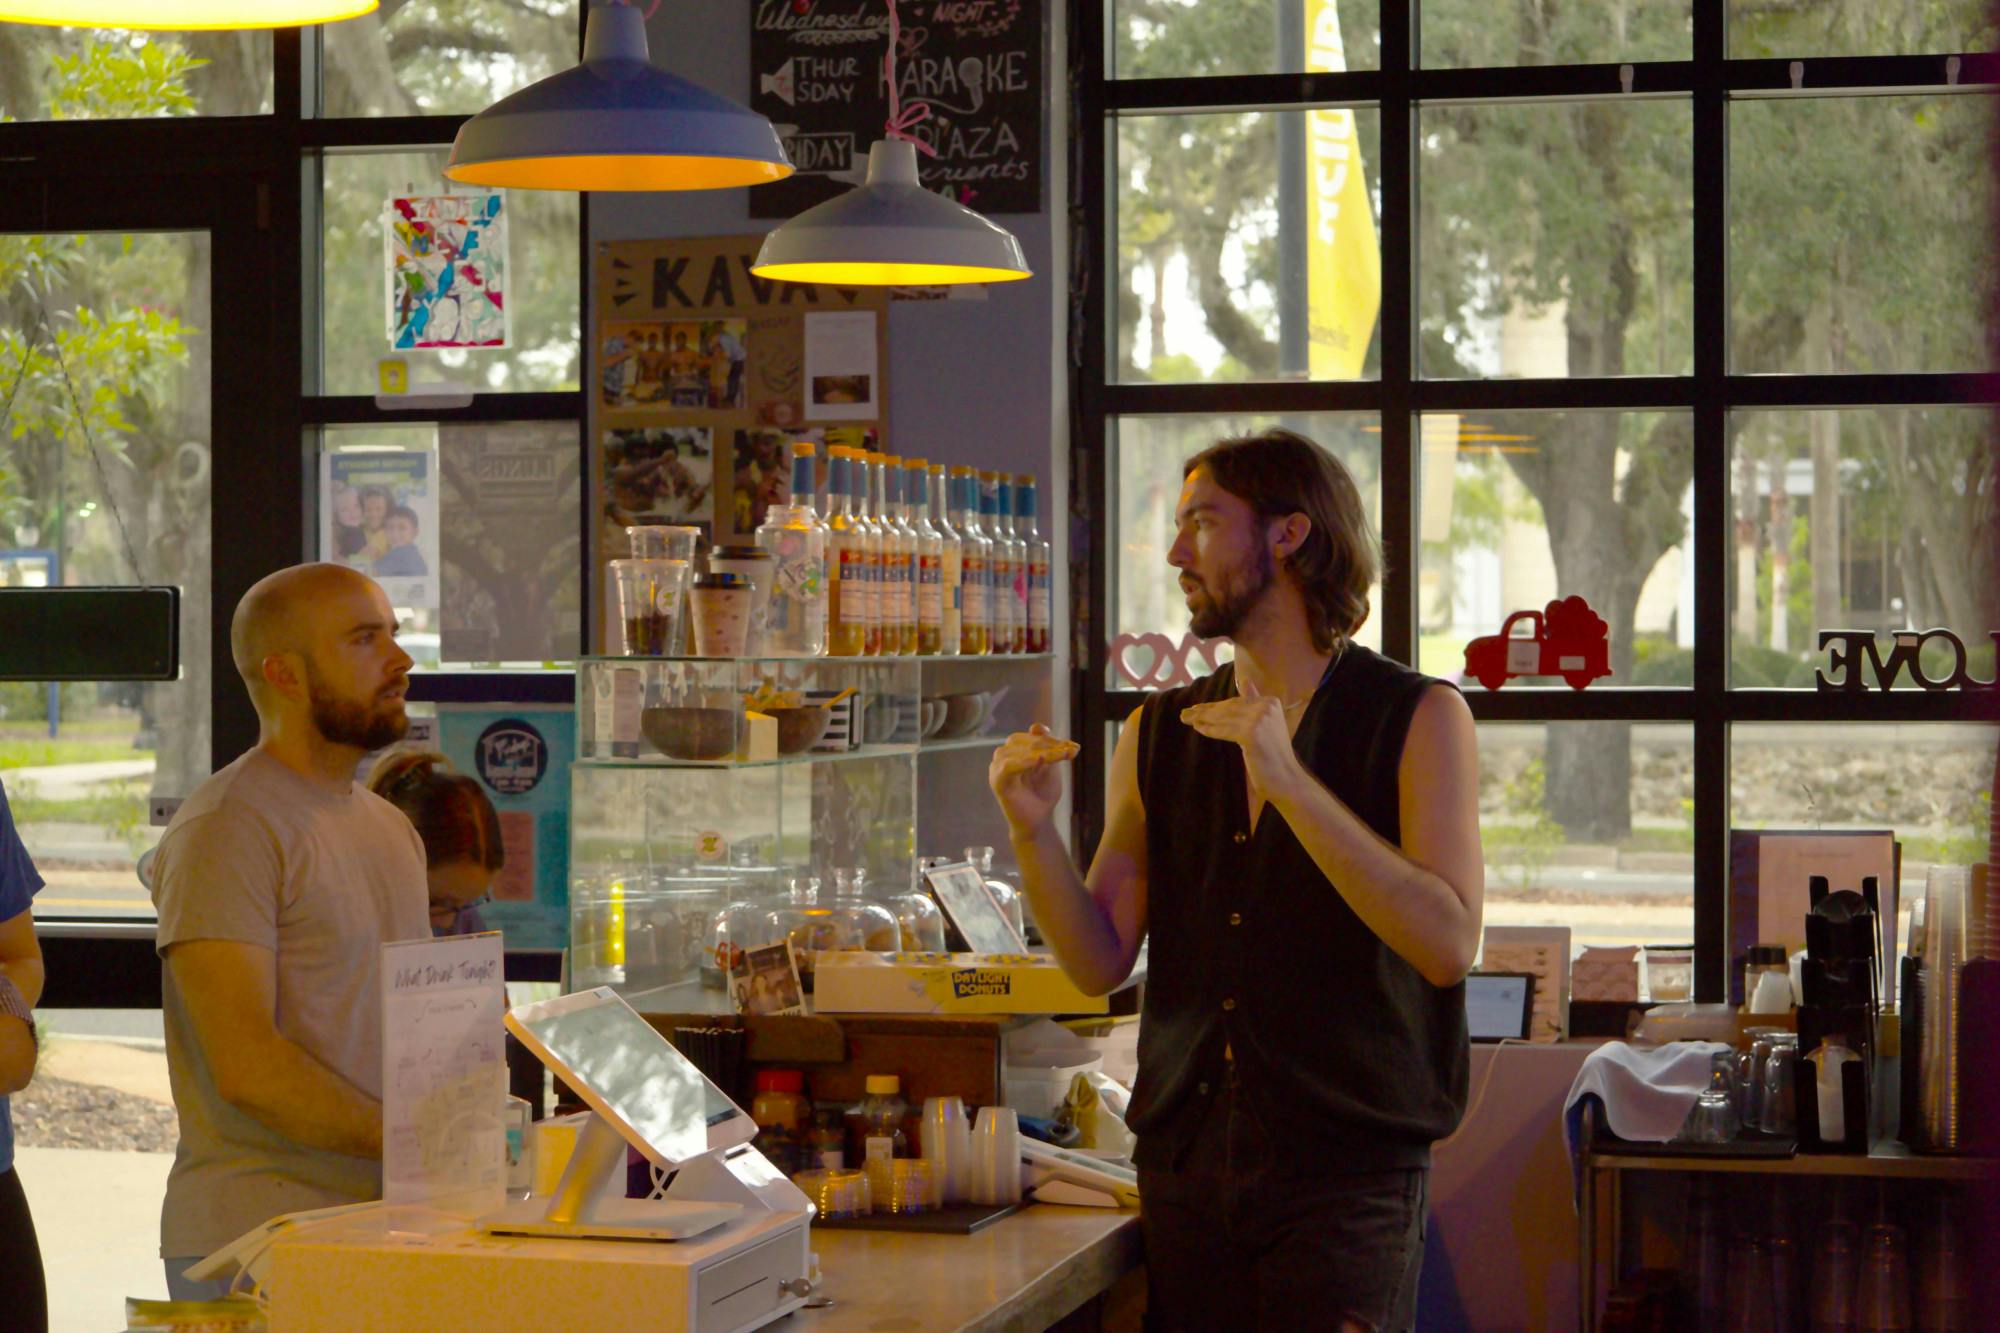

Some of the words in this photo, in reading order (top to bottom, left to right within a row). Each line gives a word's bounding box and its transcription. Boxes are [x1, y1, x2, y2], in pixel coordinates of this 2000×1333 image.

[796, 57, 860, 78] THUR
[799, 81, 855, 102] SDAY
[784, 138, 849, 170] RIDAY
[959, 983, 1006, 996] DONUTS
